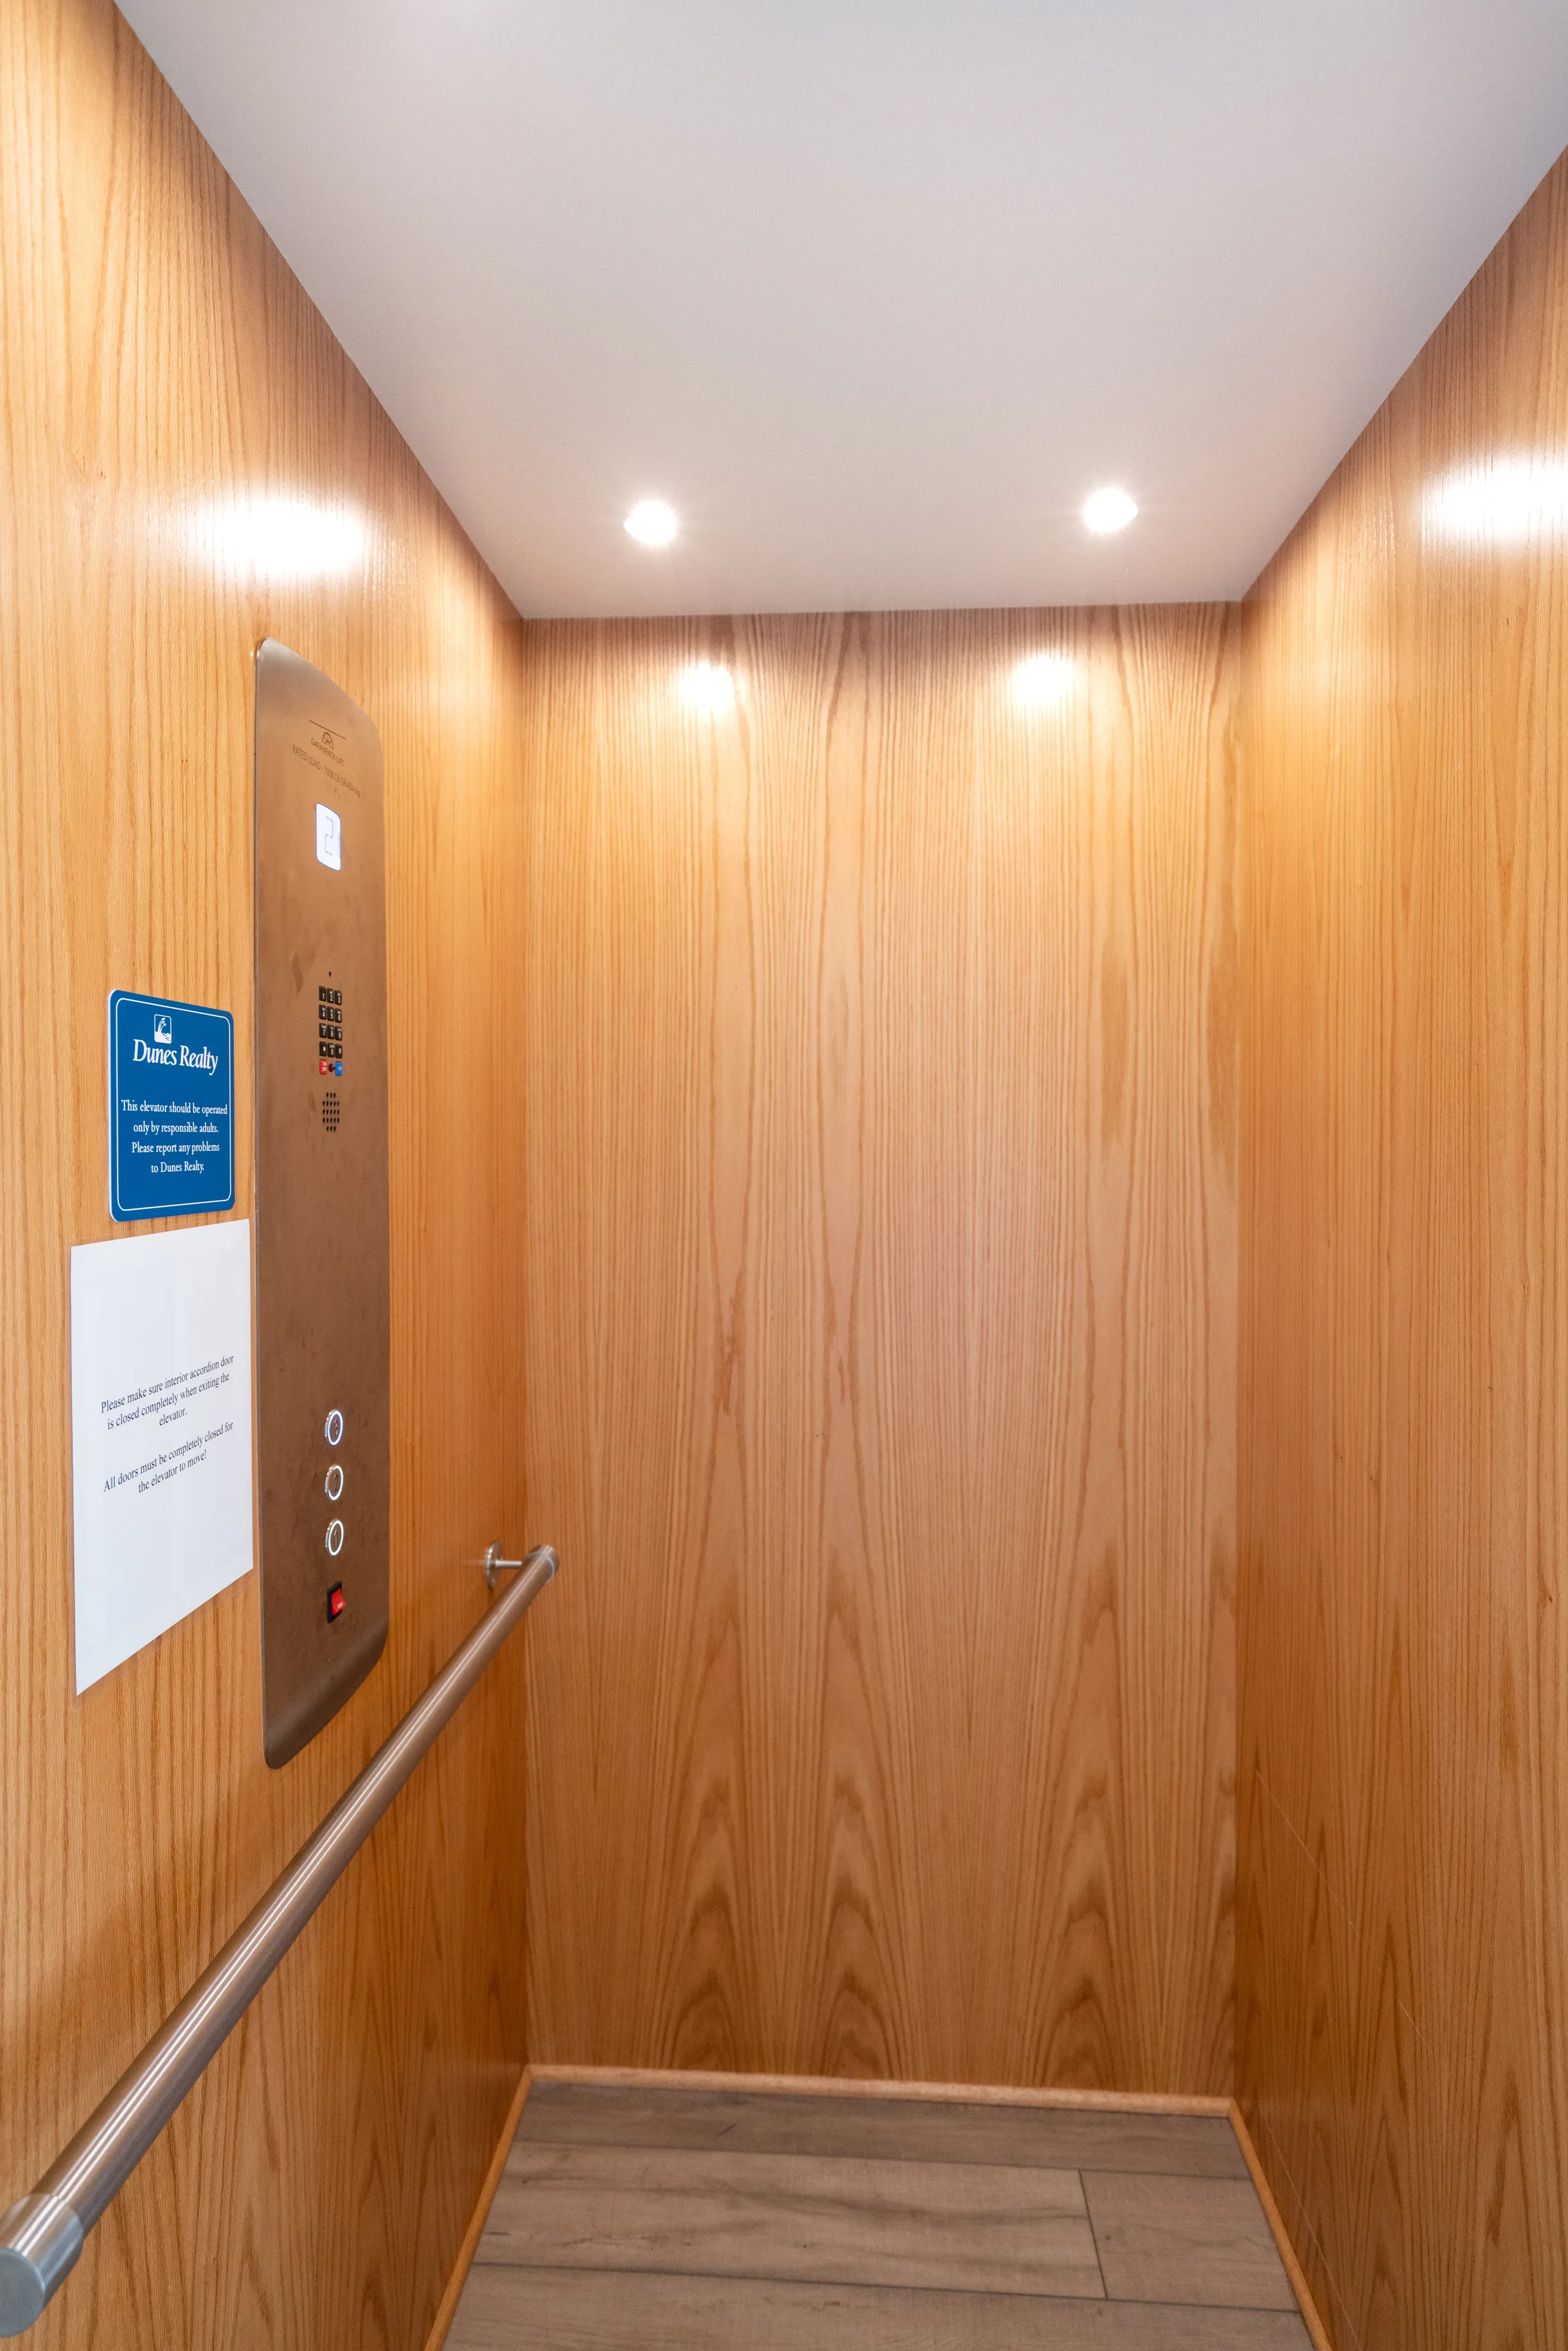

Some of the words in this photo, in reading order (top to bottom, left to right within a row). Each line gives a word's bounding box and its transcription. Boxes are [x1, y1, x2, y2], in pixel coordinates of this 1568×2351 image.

[311, 738, 335, 761] GARAVENTA
[336, 756, 344, 766] LIFT
[292, 744, 307, 761] RATED
[308, 755, 320, 770] LOAD
[324, 766, 334, 779] 1000
[335, 774, 339, 783] LB
[341, 777, 346, 786] OR
[133, 1039, 177, 1066] Dunes
[179, 1045, 218, 1075] Realty
[121, 1100, 138, 1112] This
[140, 1100, 167, 1113] elevator
[169, 1102, 191, 1113] should
[193, 1103, 200, 1114] be
[202, 1104, 227, 1116] operated
[134, 1121, 149, 1134] only
[151, 1122, 160, 1136] by
[161, 1122, 197, 1136] responsible
[199, 1123, 218, 1132] adults.
[132, 1141, 154, 1153] Please
[156, 1143, 177, 1156] report
[179, 1144, 190, 1155] any
[192, 1143, 220, 1154] problems
[151, 1164, 158, 1173] to
[160, 1163, 182, 1173] Dunes
[184, 1161, 204, 1173] Realty.
[101, 1397, 125, 1413] Please
[127, 1388, 147, 1403] make
[148, 1383, 163, 1395] sure
[165, 1372, 189, 1389] interior
[190, 1360, 219, 1379] accordion
[220, 1355, 234, 1366] door
[107, 1418, 114, 1429] is
[116, 1407, 139, 1426] closed
[141, 1393, 178, 1415] completely
[181, 1387, 197, 1399] when
[199, 1377, 219, 1392] exiting
[220, 1372, 229, 1383] the
[159, 1408, 187, 1426] elevator.
[334, 1419, 338, 1436] 3
[103, 1476, 116, 1492] All
[118, 1468, 138, 1485] doors
[140, 1459, 157, 1474] must
[159, 1454, 166, 1465] be
[168, 1436, 203, 1460] completely
[204, 1425, 223, 1442] closed
[225, 1422, 233, 1433] for
[138, 1480, 149, 1493] the
[151, 1467, 177, 1486] elevator
[179, 1461, 186, 1470] to
[188, 1449, 206, 1468] move!
[334, 1474, 339, 1492] 2
[334, 1530, 337, 1546] 1
